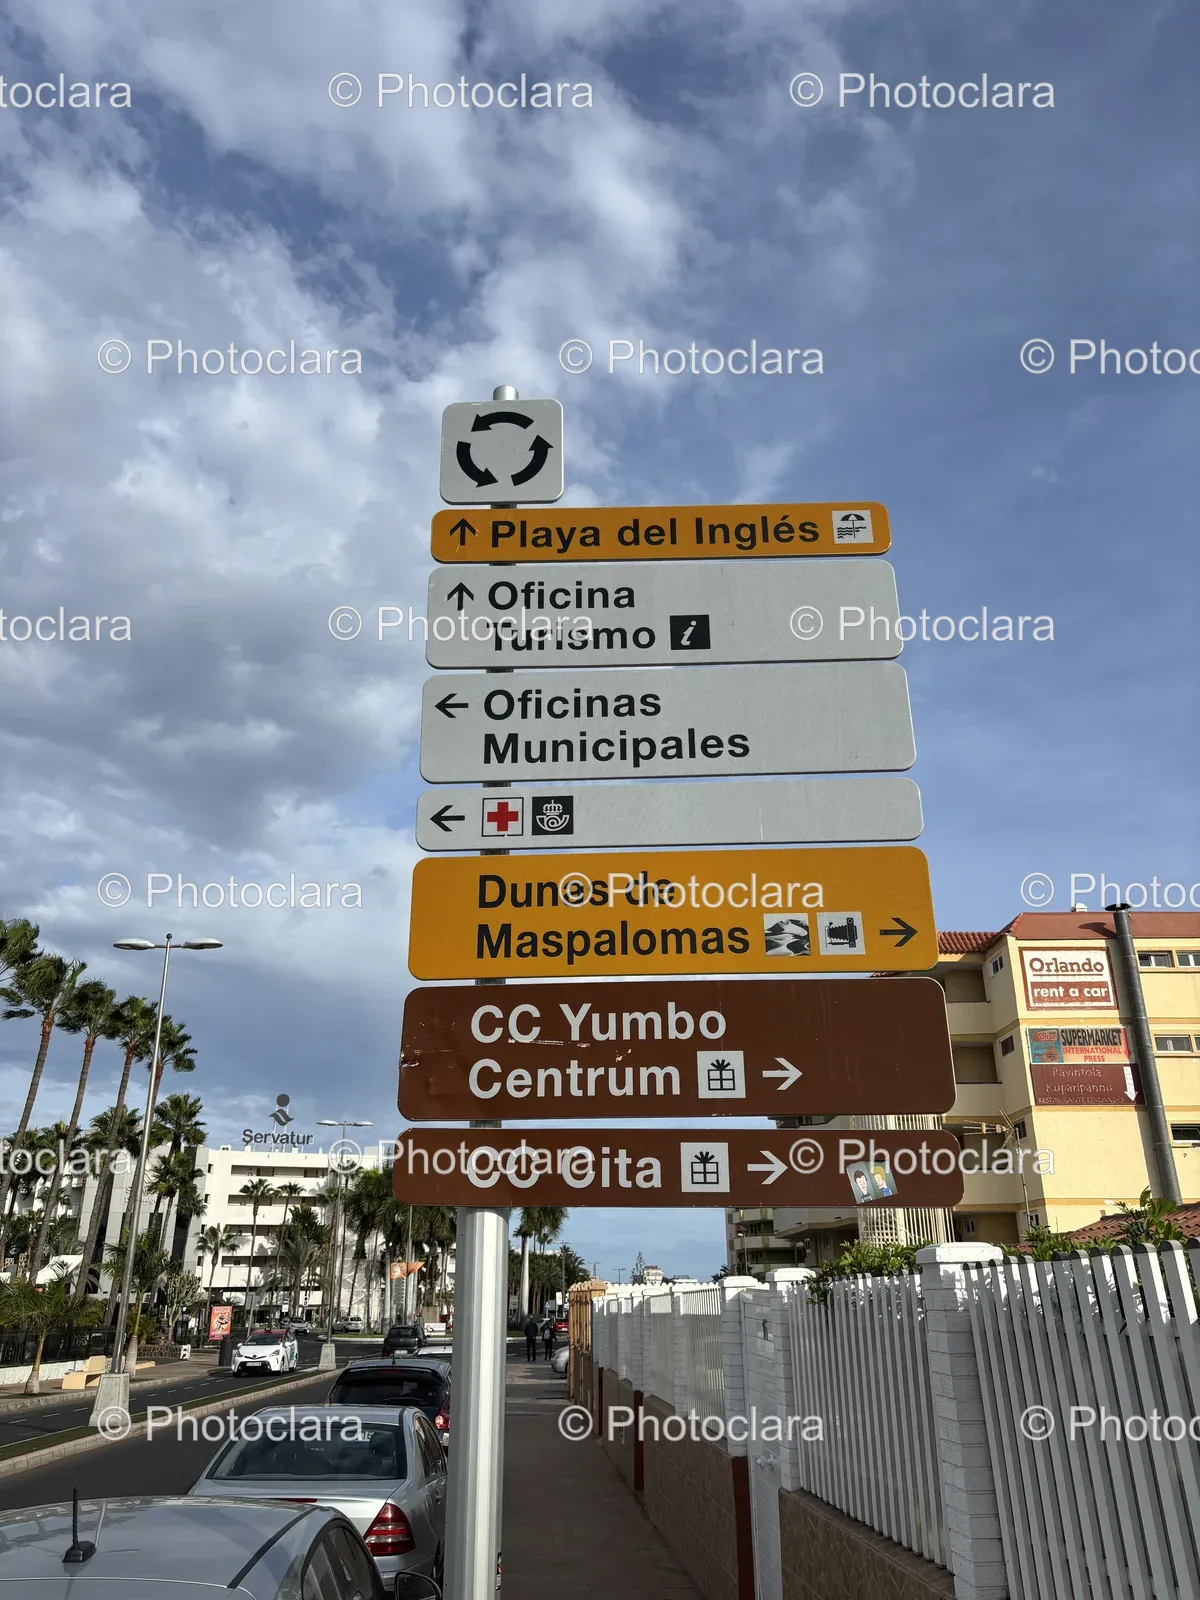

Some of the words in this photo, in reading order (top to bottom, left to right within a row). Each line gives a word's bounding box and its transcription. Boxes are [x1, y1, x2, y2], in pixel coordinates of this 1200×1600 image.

[491, 520, 600, 553] Playa
[617, 519, 677, 546] del
[695, 513, 820, 551] Inglés
[488, 580, 636, 609] Oficina
[487, 622, 656, 651] Turismo
[483, 689, 661, 721] Oficinas
[483, 729, 750, 768] Municipales
[478, 874, 609, 908] Dunas
[626, 870, 677, 906] de
[476, 920, 750, 965] Maspalomas
[1029, 957, 1104, 973] Orlando
[1033, 986, 1064, 998] rent
[1069, 987, 1079, 998] a
[1083, 987, 1108, 998] car
[470, 1003, 541, 1044] CC
[559, 1001, 727, 1041] Yumbo
[1061, 1028, 1122, 1046] SUPERMARKET
[1063, 1046, 1122, 1054] INTERNATIONAL
[468, 1058, 680, 1099] Centrum
[1053, 1067, 1102, 1077] Ravintola
[242, 1129, 313, 1146] Servatur
[467, 1145, 541, 1189] CC
[562, 1145, 663, 1189] Cita
